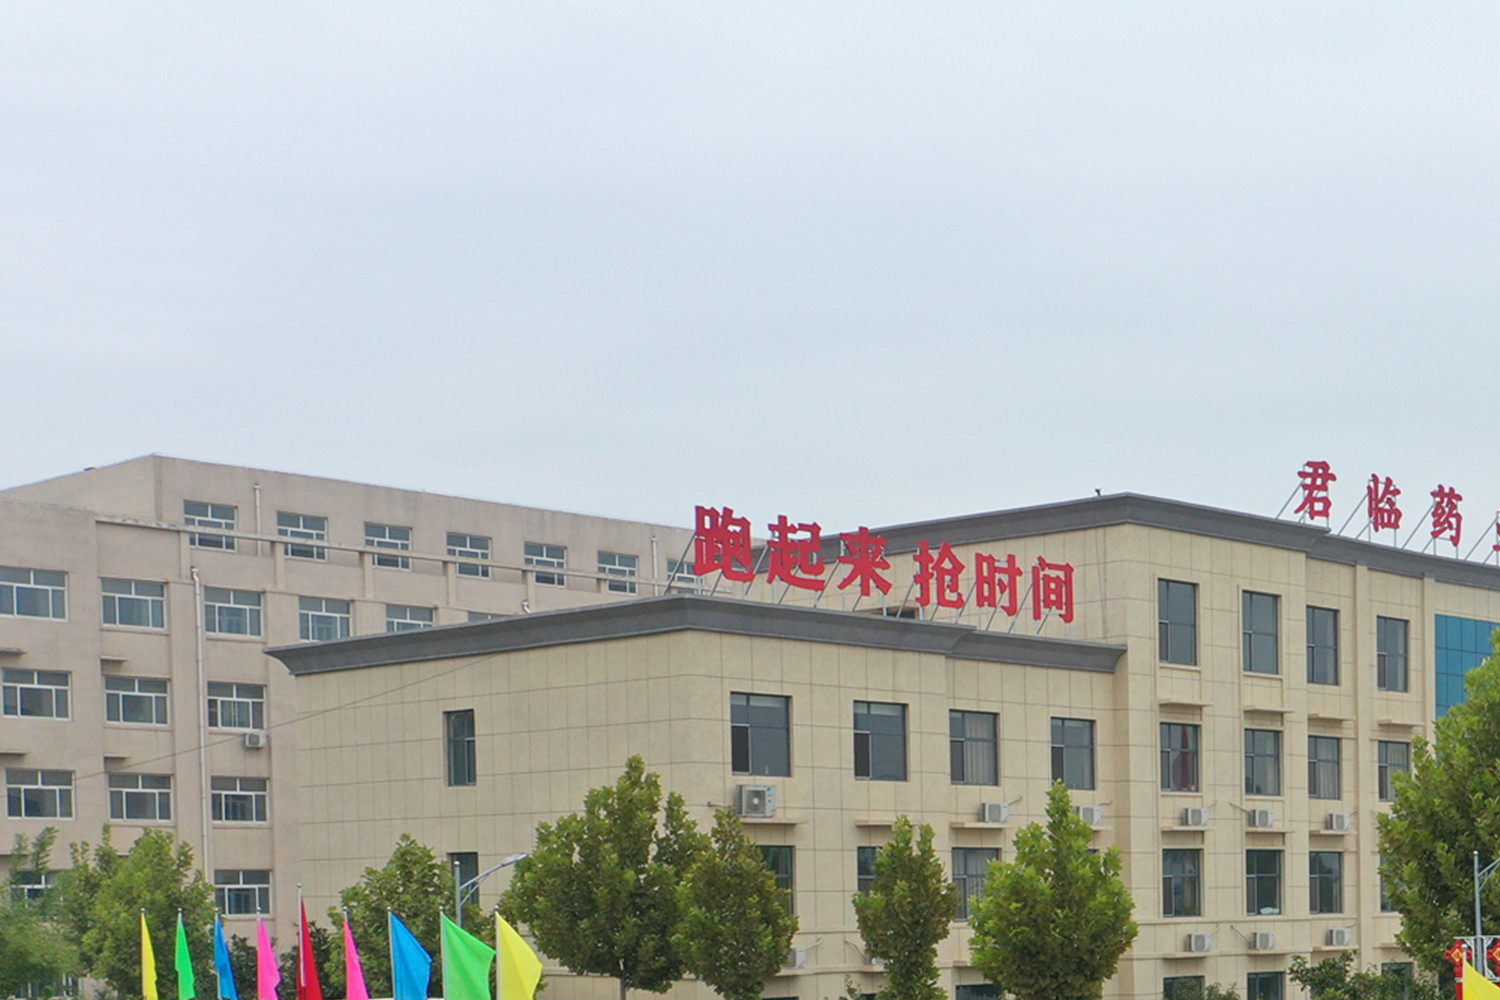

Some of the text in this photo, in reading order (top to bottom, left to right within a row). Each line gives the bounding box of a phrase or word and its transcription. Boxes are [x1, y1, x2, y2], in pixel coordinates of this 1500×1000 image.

[693, 504, 1076, 624] 跑起来抢时间
